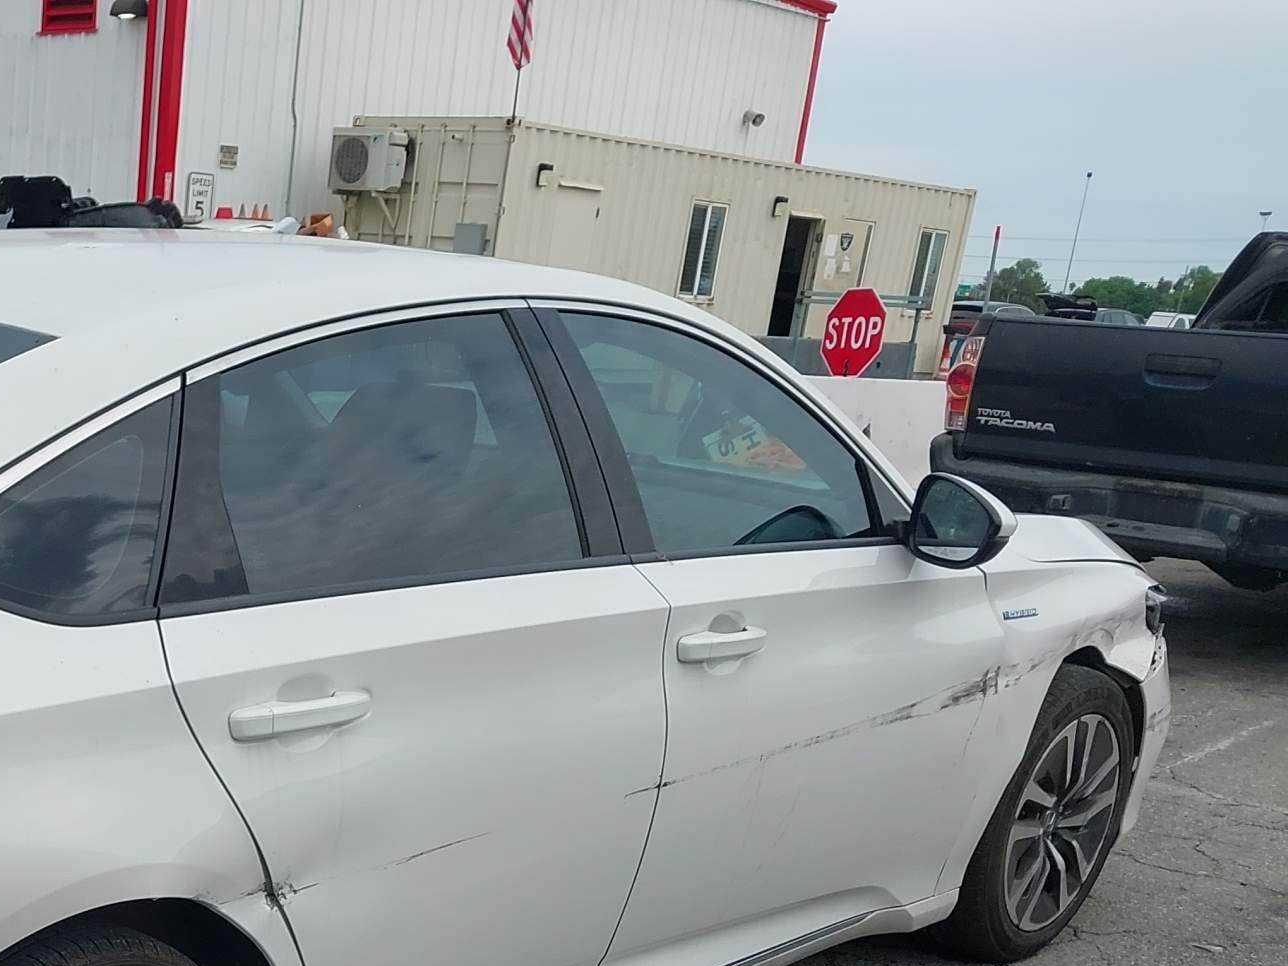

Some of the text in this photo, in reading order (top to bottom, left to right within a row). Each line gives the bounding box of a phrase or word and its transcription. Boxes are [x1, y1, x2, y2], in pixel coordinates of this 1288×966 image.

[195, 201, 204, 217] 5
[825, 316, 882, 350] STOP
[977, 408, 1011, 418] TOYOTA
[976, 416, 1056, 432] TACOMA
